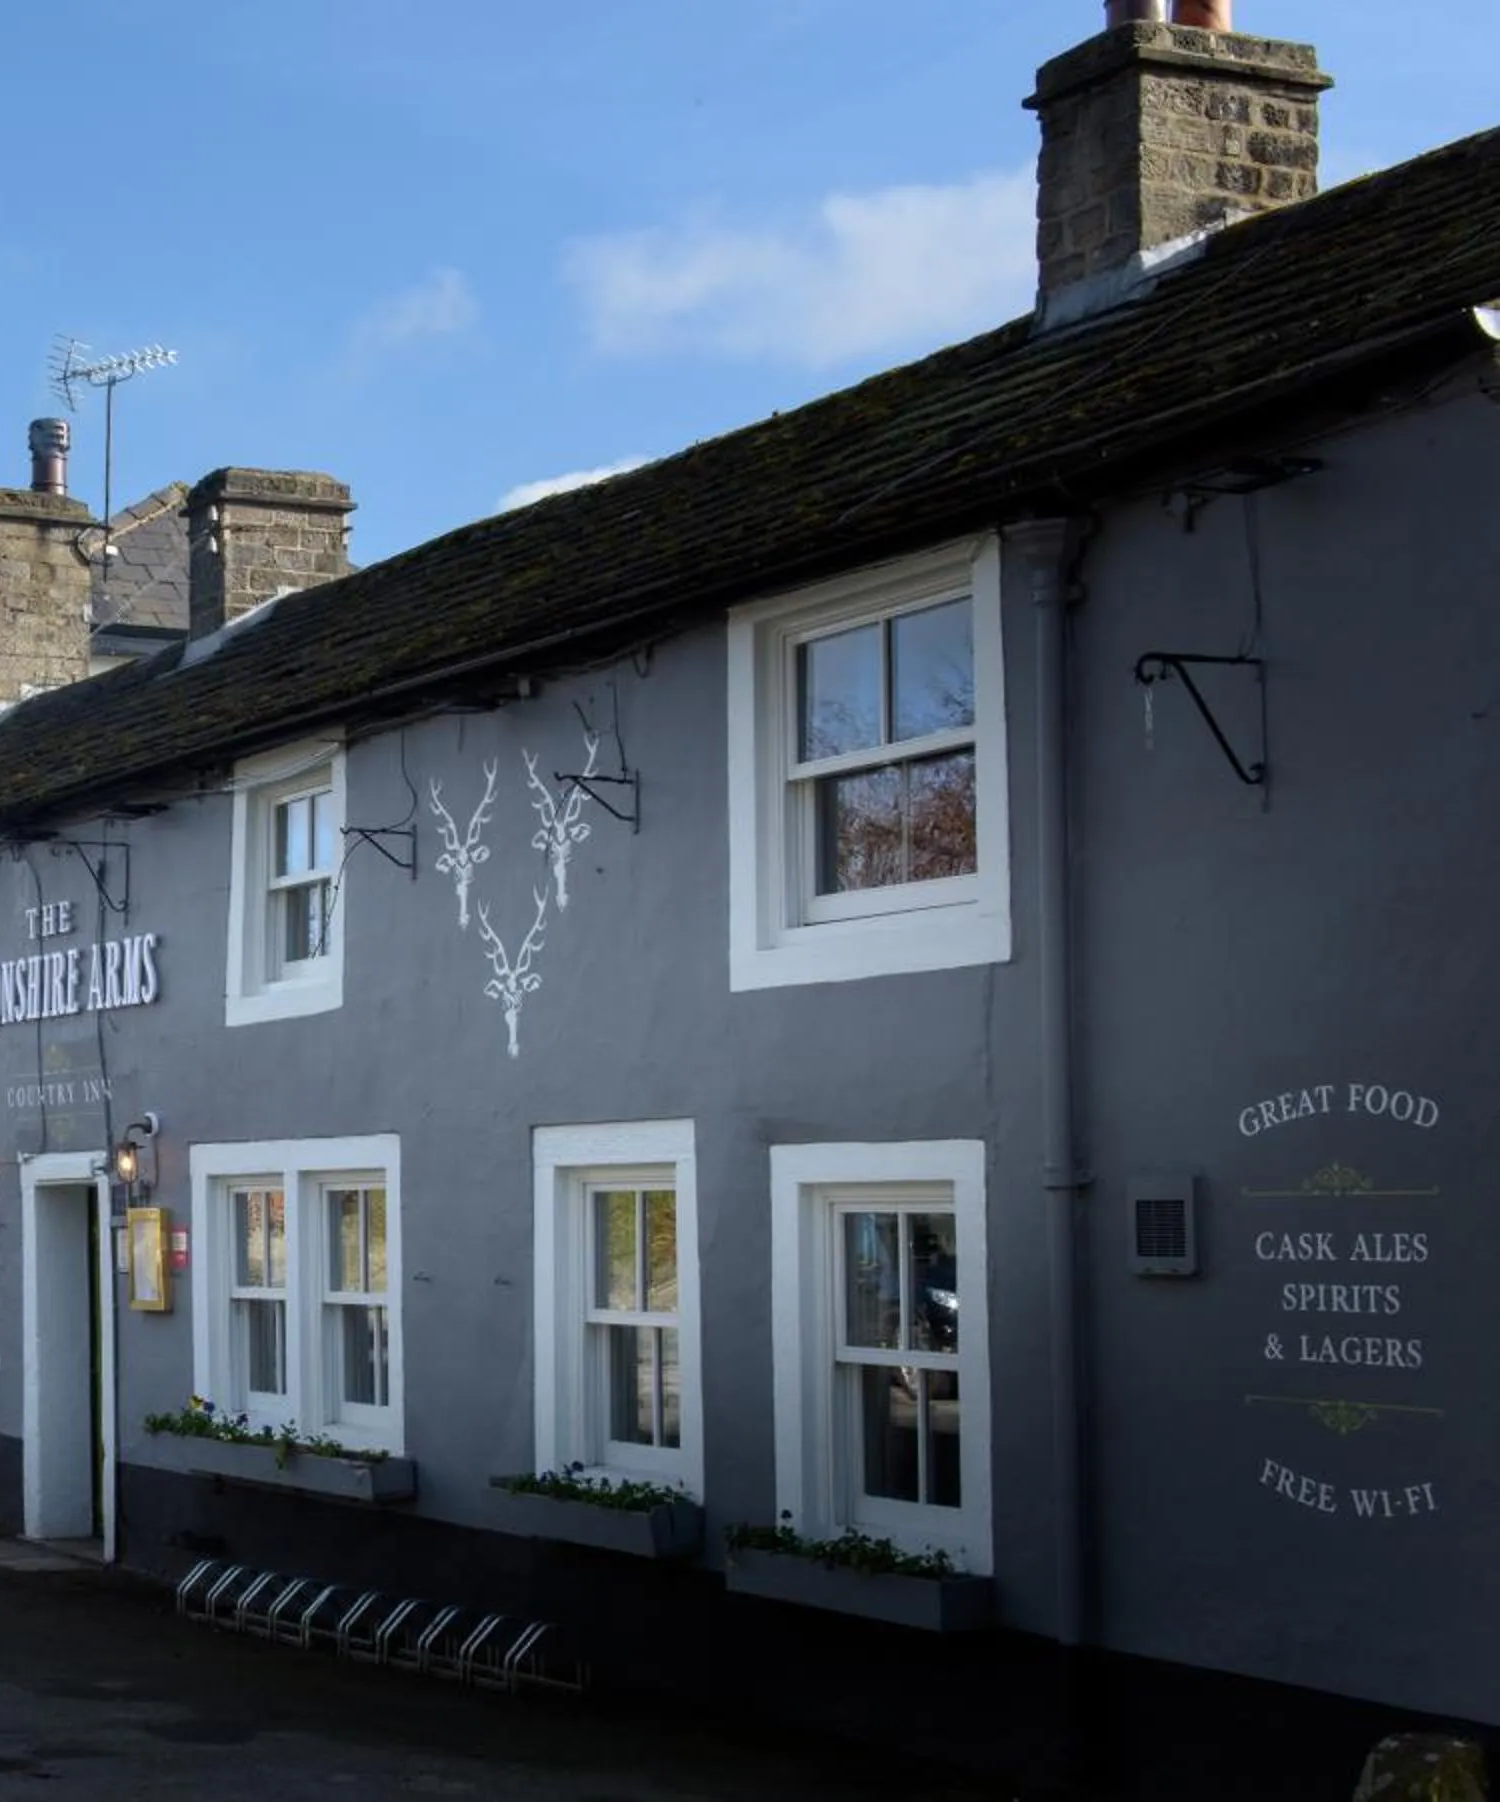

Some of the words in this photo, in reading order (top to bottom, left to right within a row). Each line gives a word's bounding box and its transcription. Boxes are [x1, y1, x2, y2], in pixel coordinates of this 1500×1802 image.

[25, 901, 71, 939] THE
[86, 932, 159, 1011] ARMS
[7, 1082, 76, 1108] COUNTRY
[83, 1079, 112, 1103] INN
[1239, 1084, 1335, 1137] GREAT
[1348, 1083, 1440, 1128] FOOD
[1255, 1231, 1339, 1261] CASK
[1350, 1233, 1429, 1263] ALES
[1282, 1283, 1401, 1315] SPIRITS
[1264, 1333, 1285, 1361] &
[1300, 1335, 1423, 1369] LAGERS
[1259, 1458, 1337, 1514] FREE
